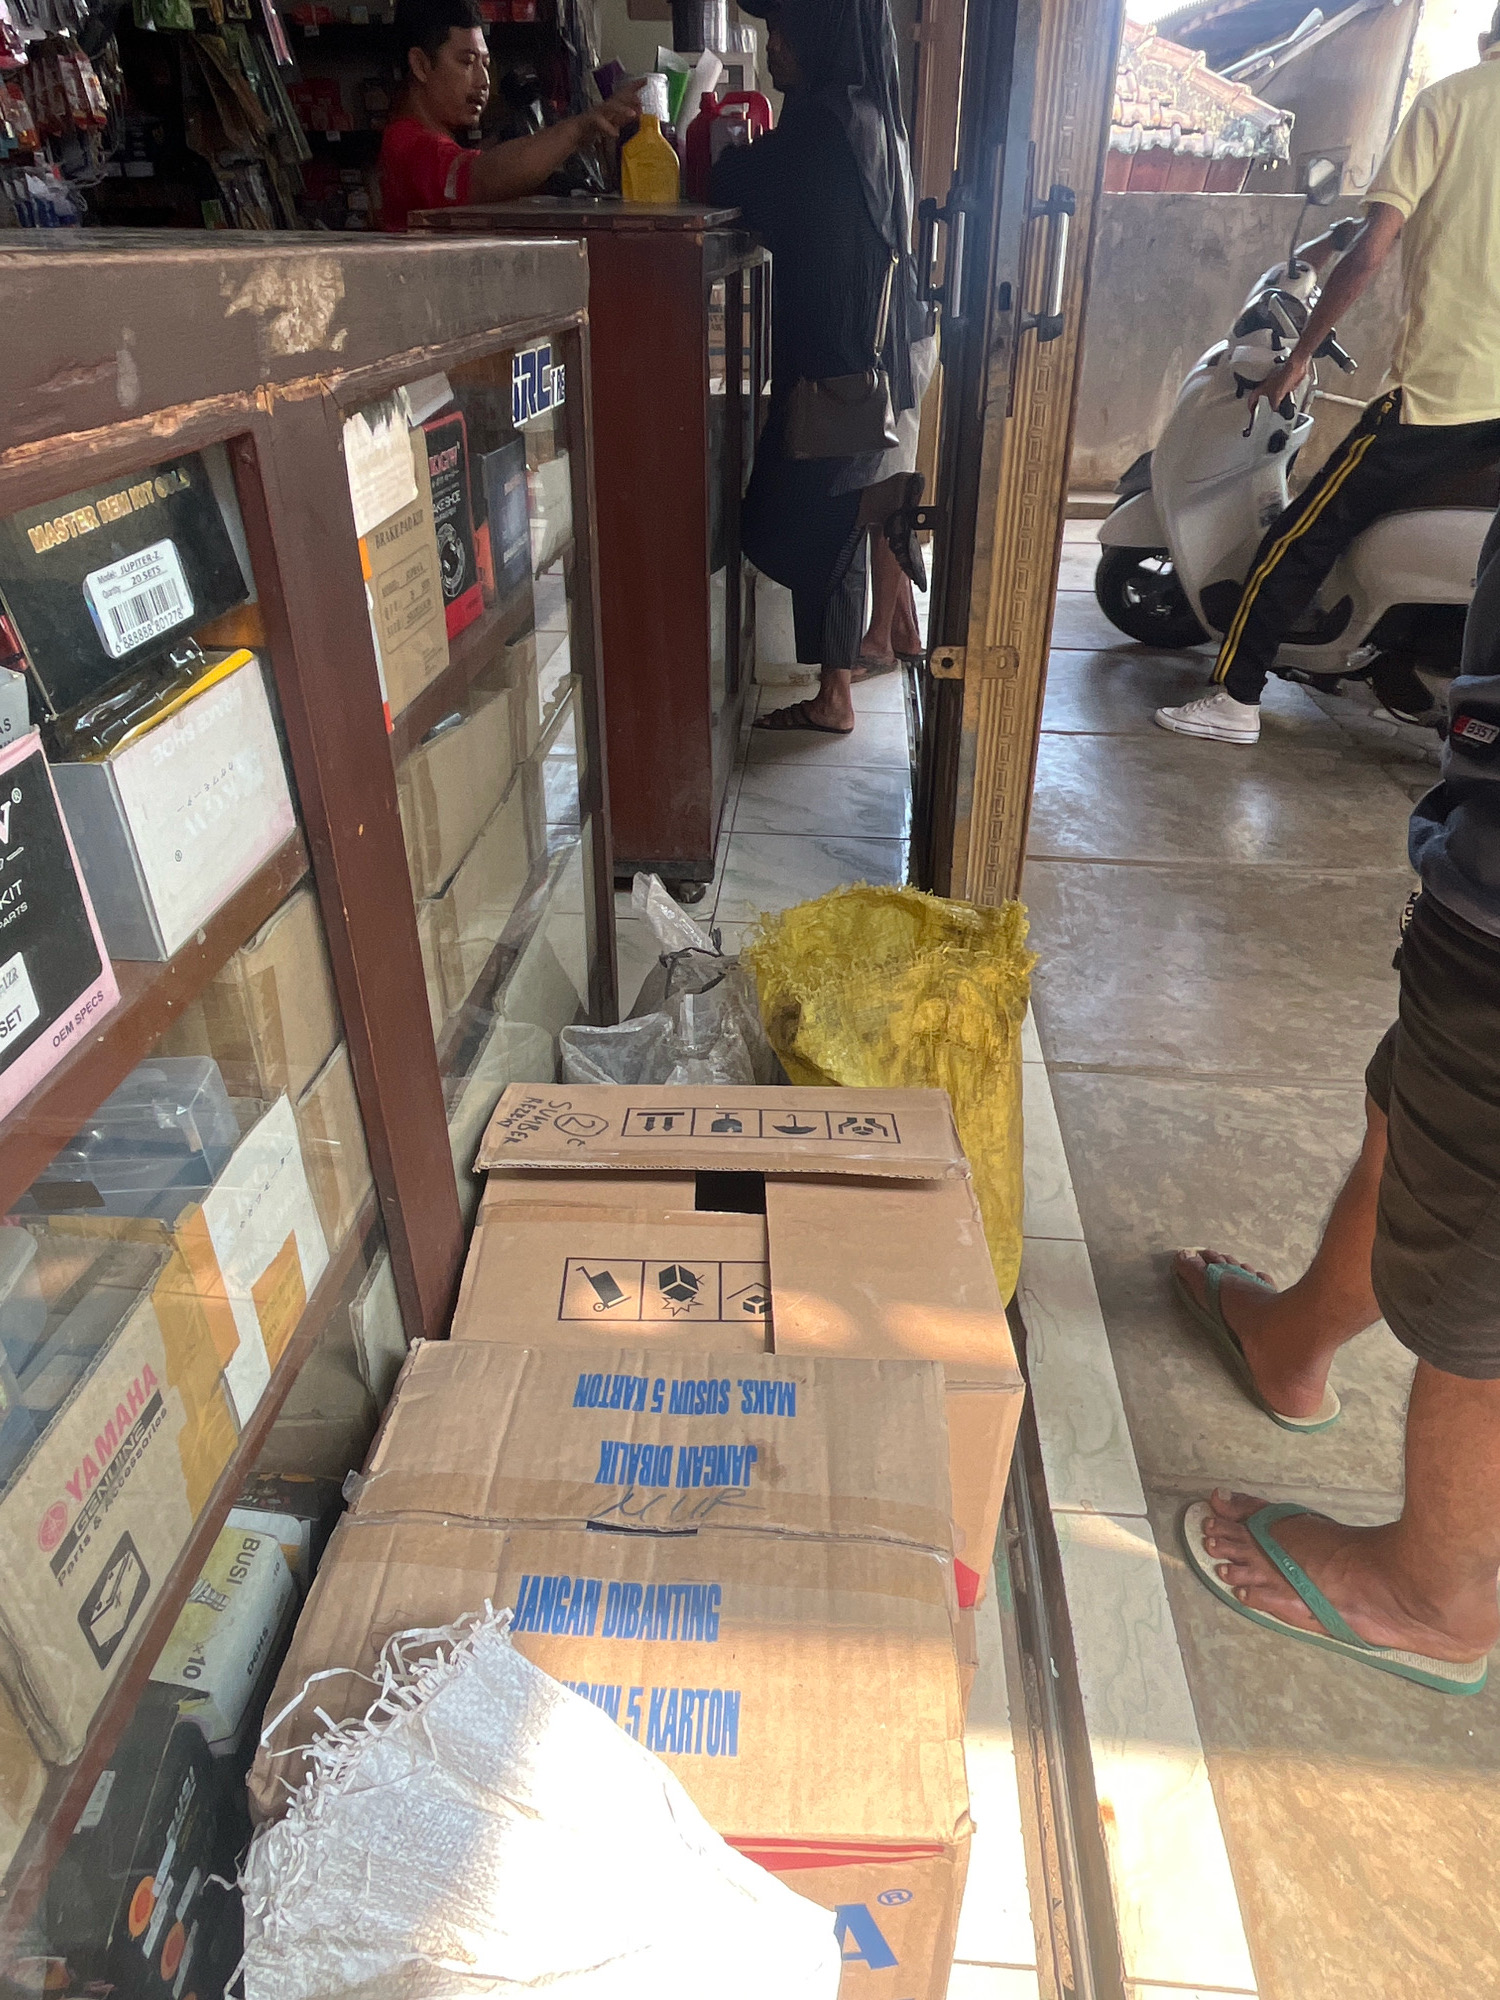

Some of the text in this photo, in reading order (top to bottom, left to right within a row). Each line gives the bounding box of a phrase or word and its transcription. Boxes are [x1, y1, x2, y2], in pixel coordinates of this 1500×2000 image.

[27, 505, 100, 554] MASTER
[119, 551, 160, 576] JUPITER-Z
[131, 574, 142, 587] 20
[142, 565, 162, 582] SETS
[0, 1004, 22, 1038] SET
[52, 990, 105, 1048] OEM SPECS
[572, 1373, 796, 1418] MAKS. SUSUN 5 KARTON
[65, 1362, 159, 1503] YAMAHA
[73, 1420, 149, 1538] GENUINE
[594, 1440, 758, 1488] JANGAN DIBALIK
[56, 1534, 93, 1588] Parts
[226, 1537, 261, 1585] BUSI
[510, 1574, 721, 1643] JANGAN DIBANTING
[624, 1686, 644, 1742] 5
[646, 1687, 741, 1757] KARTON
